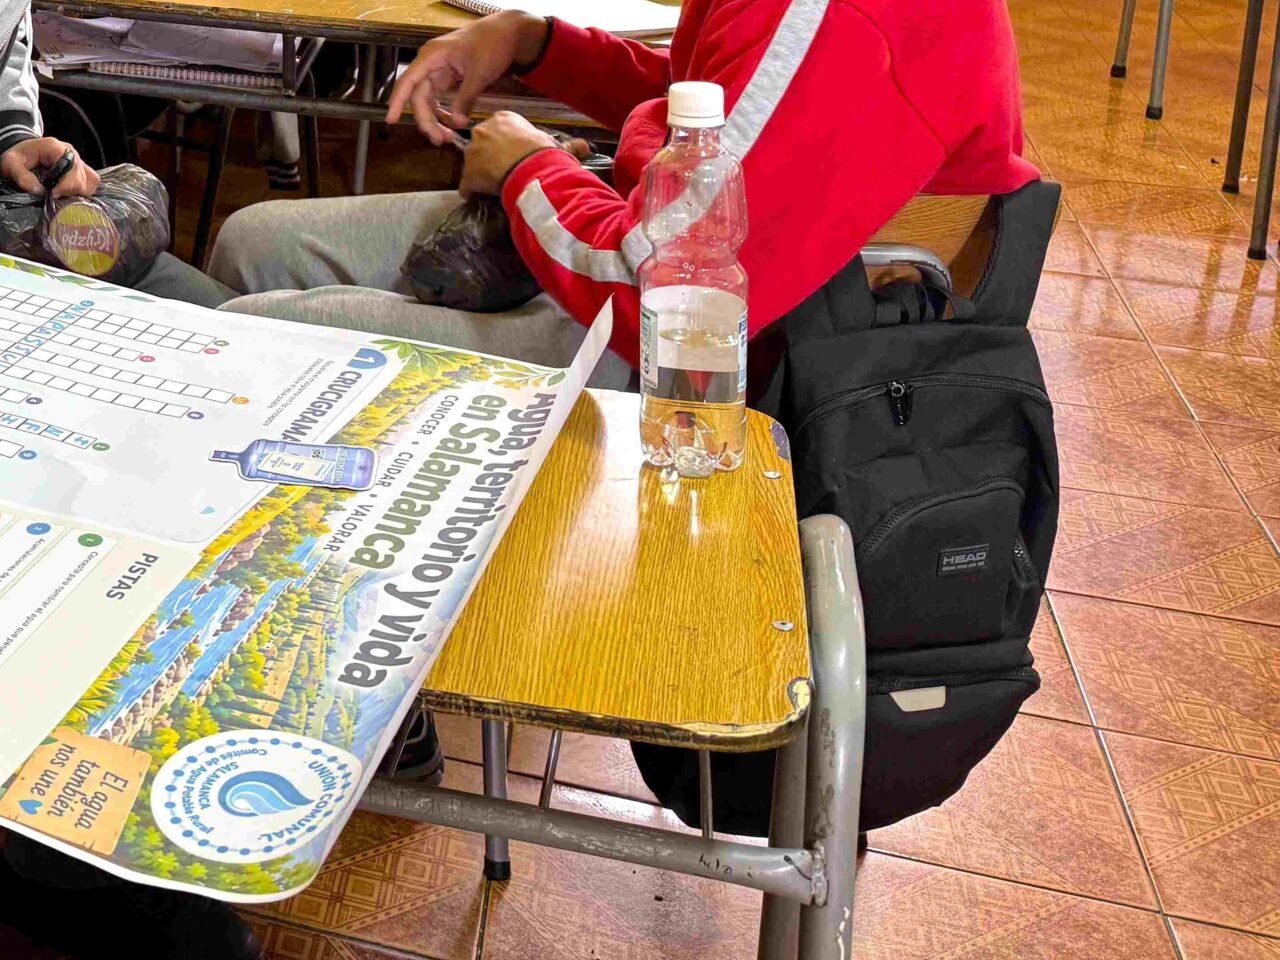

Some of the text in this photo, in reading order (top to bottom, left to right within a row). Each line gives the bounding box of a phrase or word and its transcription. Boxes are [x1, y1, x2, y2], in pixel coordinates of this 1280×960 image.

[323, 394, 460, 553] CONOCER CUIDAR VALORAR
[348, 393, 508, 570] en Salamanca
[412, 458, 530, 583] territorio
[72, 551, 98, 573] Concepto
[106, 552, 159, 601] PISTAS
[943, 552, 986, 565] HEAD
[40, 585, 63, 607] nombrar
[61, 573, 75, 585] para
[383, 582, 441, 611] y
[10, 626, 24, 637] que
[21, 613, 37, 626] agua
[337, 613, 427, 689] vida
[29, 742, 77, 798] nos une
[187, 762, 207, 787] Agua
[202, 755, 222, 767] de
[46, 758, 102, 819] también
[74, 769, 130, 832] El agua
[184, 784, 197, 814] Potable
[199, 761, 240, 810] SALAMANCA
[261, 760, 335, 841] UNIÓN COMUNAL
